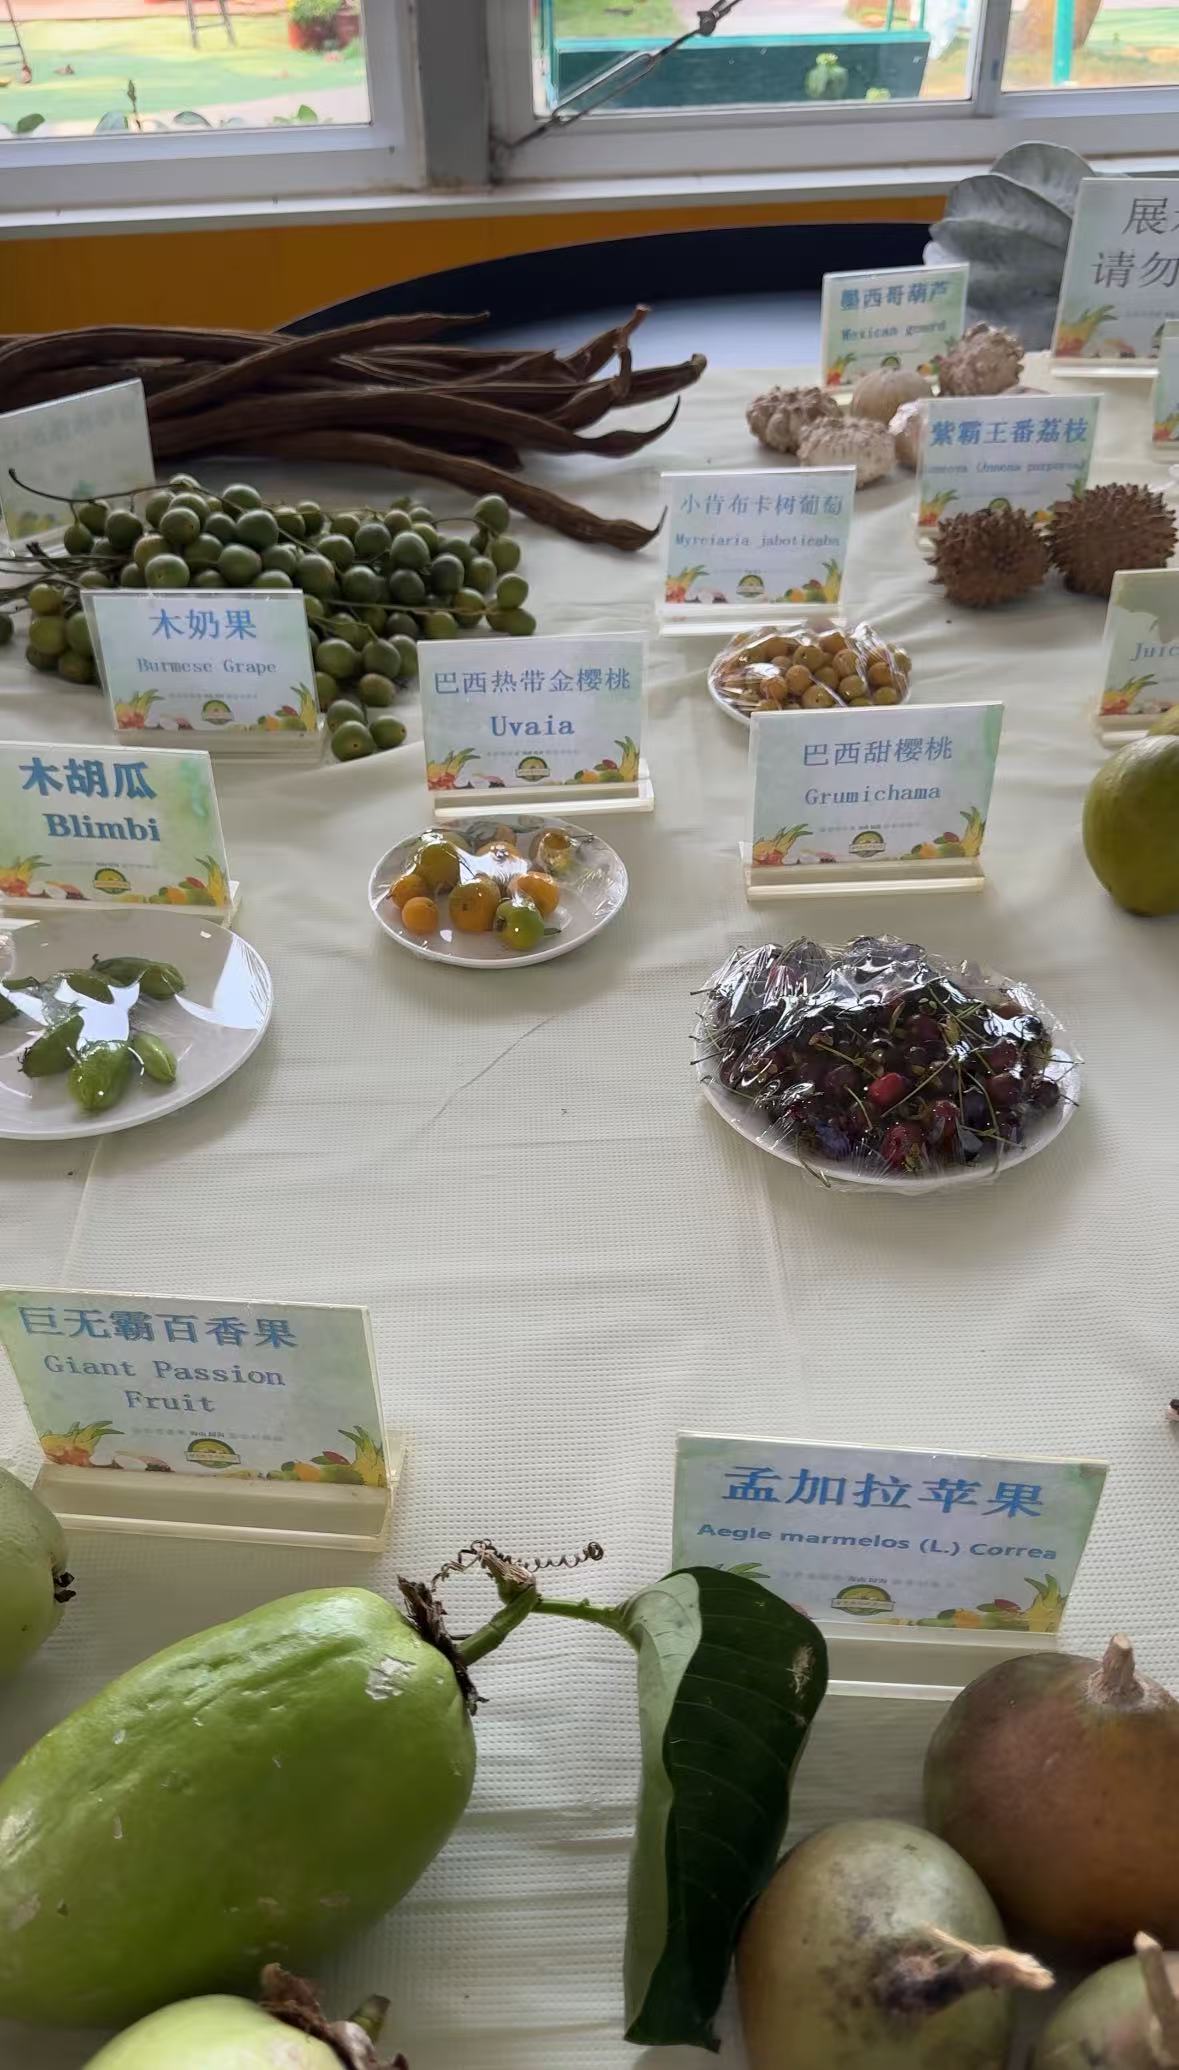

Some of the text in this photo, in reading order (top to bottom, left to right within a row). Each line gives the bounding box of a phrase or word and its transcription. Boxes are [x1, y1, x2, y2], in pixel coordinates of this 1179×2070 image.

[1121, 198, 1179, 235] 展
[1091, 251, 1179, 289] 请勿
[930, 416, 1089, 446] 紫霸王番荔枝
[681, 494, 844, 516] 小肯布卡树葡萄
[149, 608, 258, 642] 木奶果
[136, 655, 278, 677] Burmese Grape
[434, 667, 631, 696] 巴西热带金樱桃
[490, 714, 575, 737] Uvaia
[802, 735, 953, 767] 巴西甜樱桃
[19, 757, 158, 801] 木胡瓜
[804, 782, 942, 807] Grumichama
[43, 812, 161, 843] Blimbi
[17, 1306, 299, 1350] 巨无霸百香果
[43, 1354, 286, 1387] Giant Passion
[125, 1390, 216, 1414] Fruit
[721, 1465, 1044, 1519] 孟加拉苹果
[696, 1523, 1058, 1561] Aegle marmelos (L.) Correa
